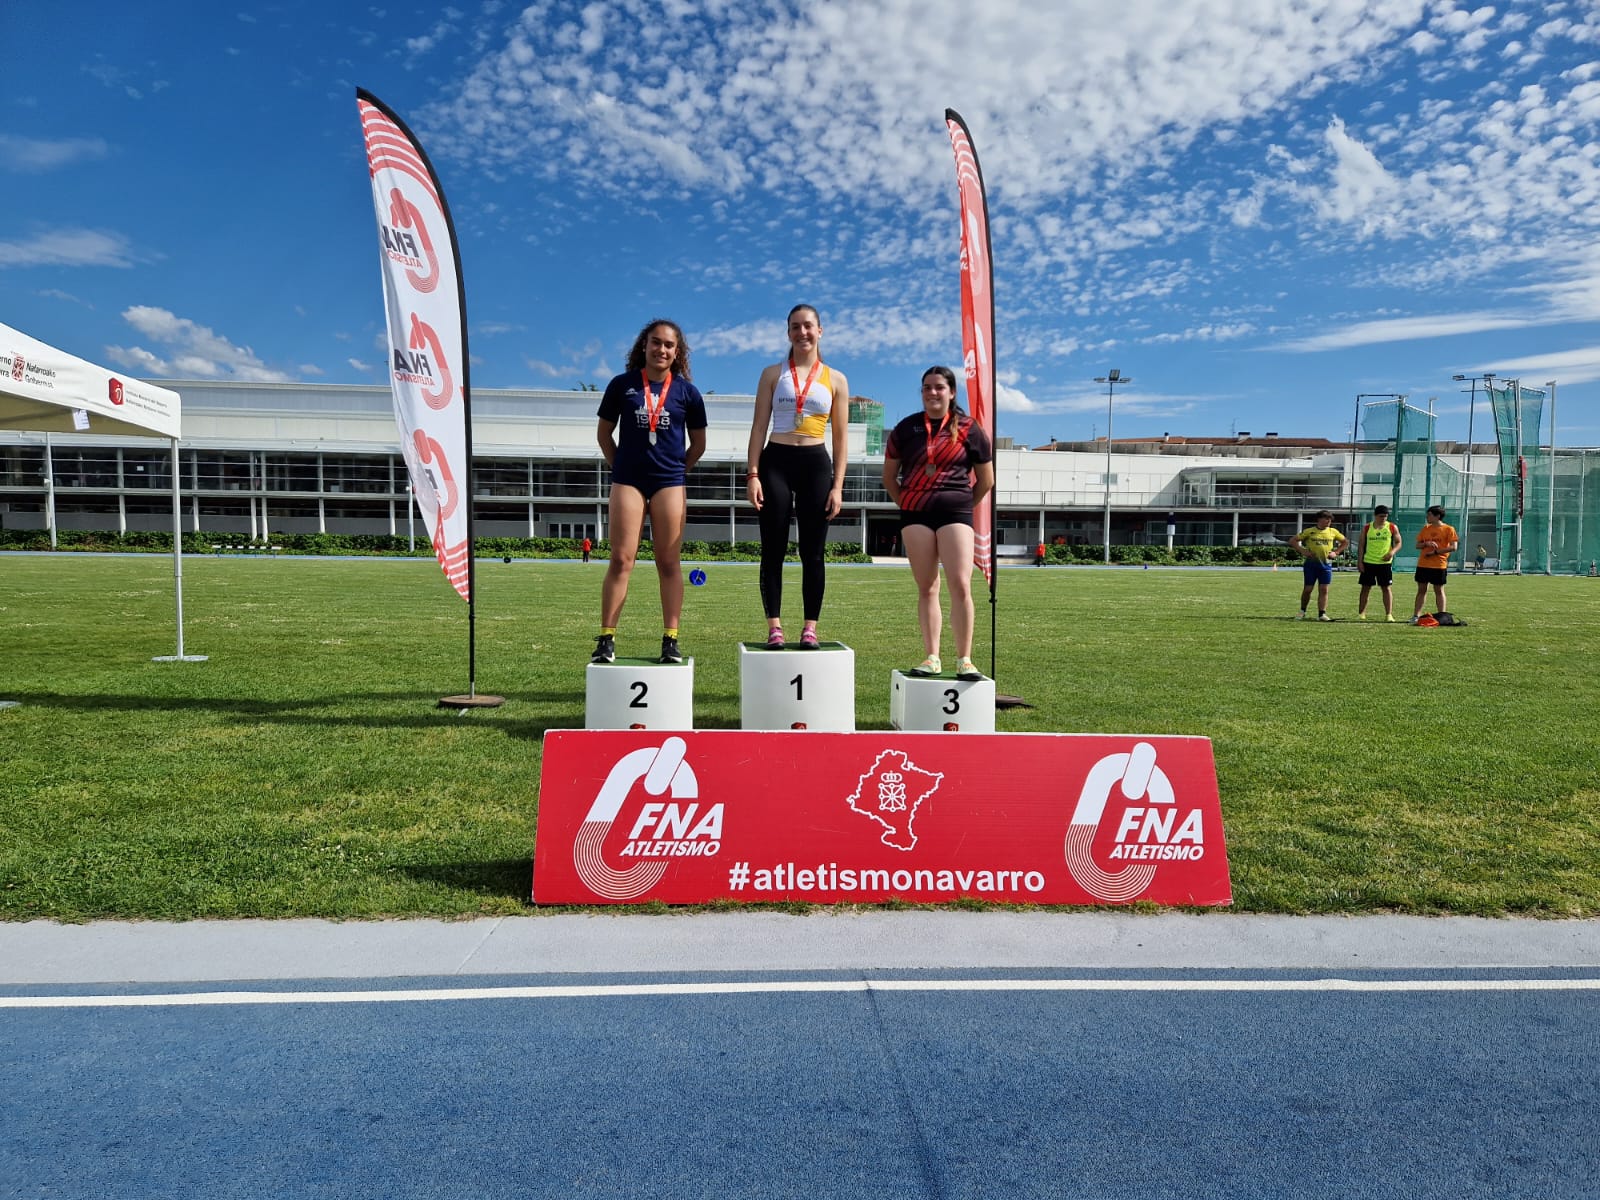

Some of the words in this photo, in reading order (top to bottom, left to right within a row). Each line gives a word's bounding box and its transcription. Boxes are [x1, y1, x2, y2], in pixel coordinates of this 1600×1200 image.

[636, 414, 670, 426] 198
[629, 681, 649, 708] 2
[790, 674, 803, 701] 1
[942, 688, 960, 715] 3
[628, 802, 725, 840] FNA
[1114, 807, 1204, 844] FNA
[619, 840, 721, 857] ATLETISMO
[1108, 844, 1204, 861] ATLETISMO
[728, 861, 1046, 892] #atletismonavarro
